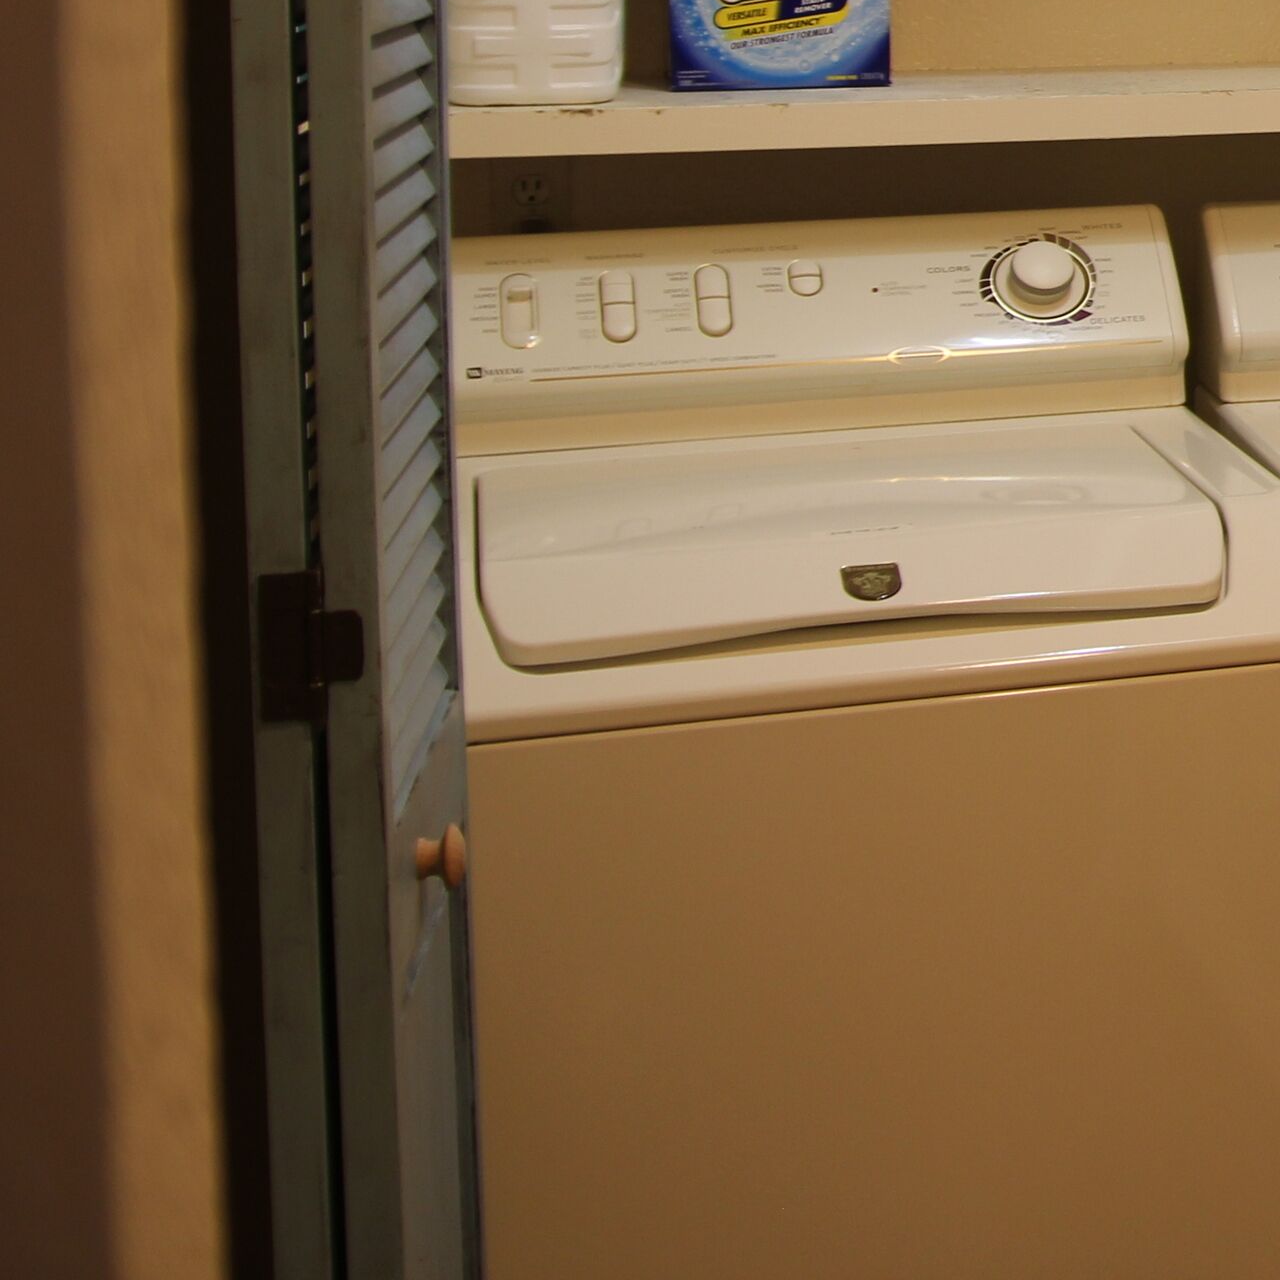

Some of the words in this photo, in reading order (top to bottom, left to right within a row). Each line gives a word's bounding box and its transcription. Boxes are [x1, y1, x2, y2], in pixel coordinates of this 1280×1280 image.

[741, 26, 766, 37] MAX
[1081, 223, 1123, 231] WHITES
[926, 265, 971, 274] COLORS
[1090, 315, 1145, 324] DELICATES
